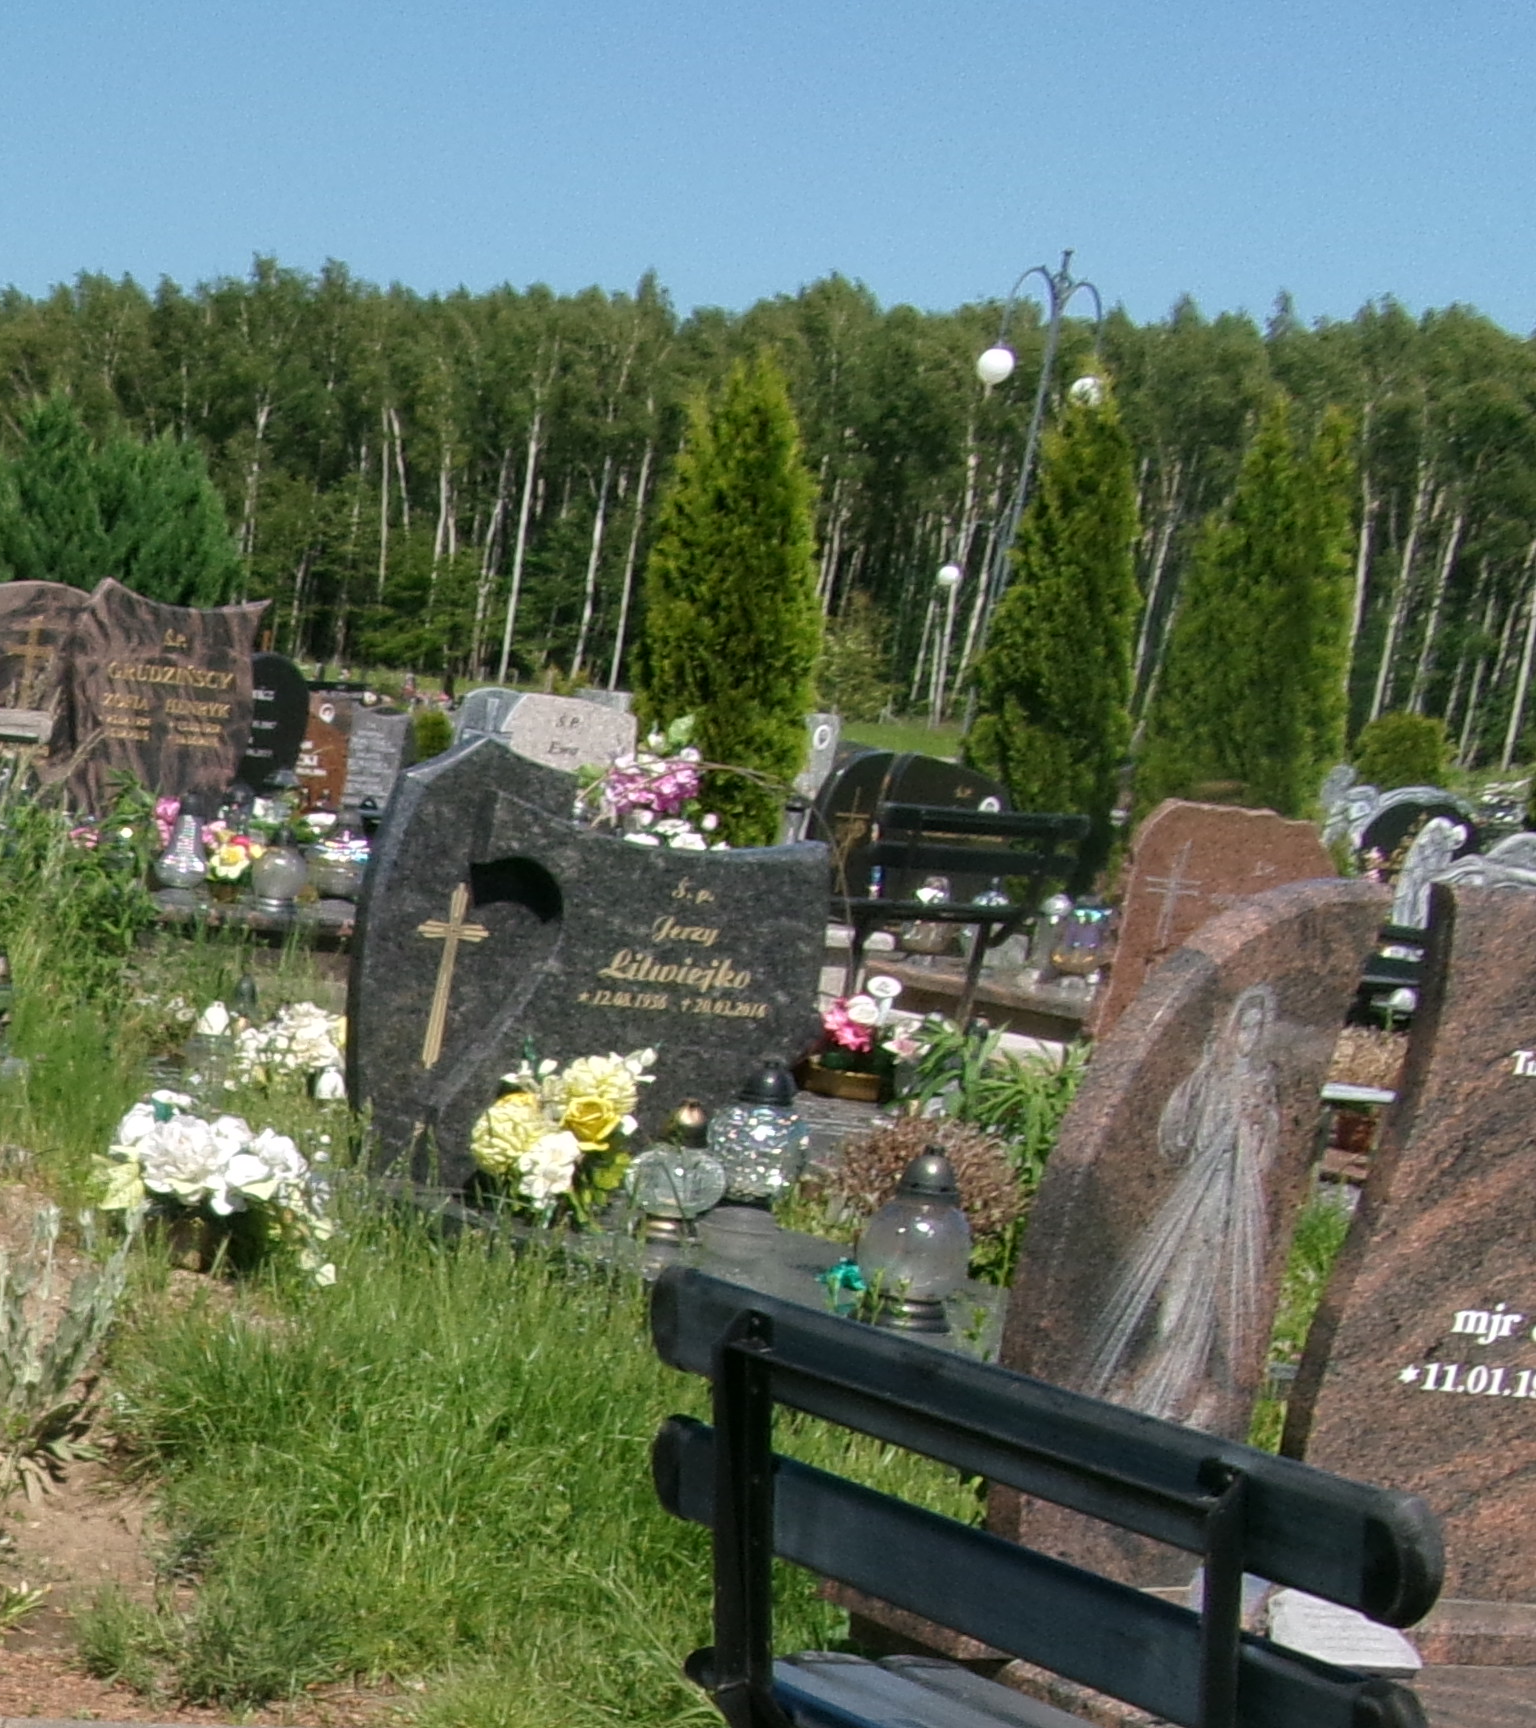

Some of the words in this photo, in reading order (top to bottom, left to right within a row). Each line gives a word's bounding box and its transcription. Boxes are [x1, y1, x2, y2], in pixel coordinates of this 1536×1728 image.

[107, 661, 236, 690] GRUDZIŃSCY
[652, 915, 721, 948] Jerzy
[1451, 1303, 1523, 1344] mjr
